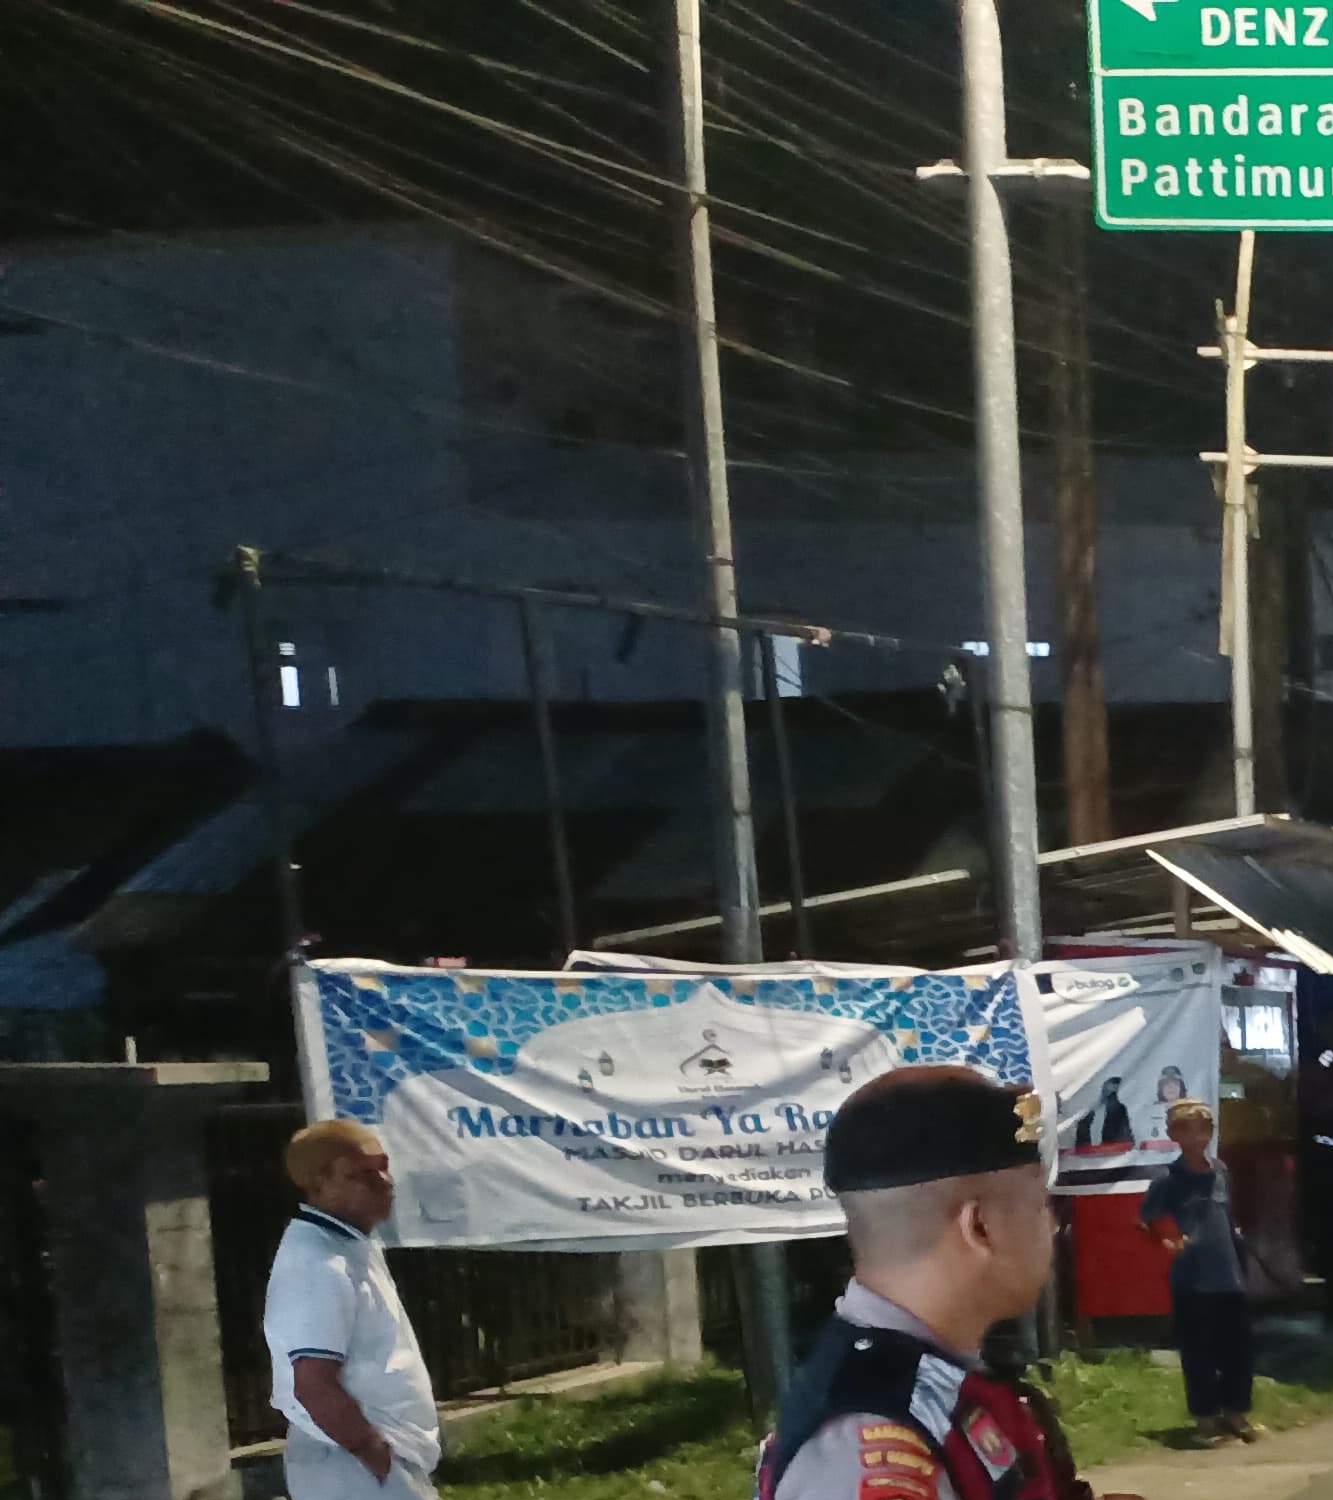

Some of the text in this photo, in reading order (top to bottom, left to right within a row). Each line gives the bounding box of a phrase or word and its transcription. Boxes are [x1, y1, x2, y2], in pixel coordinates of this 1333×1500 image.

[447, 1102, 836, 1139] Marhaban Ya Ra
[564, 1139, 827, 1161] MASJID DARUL HAS
[577, 1187, 838, 1212] TAKJIL BERBUKA PU
